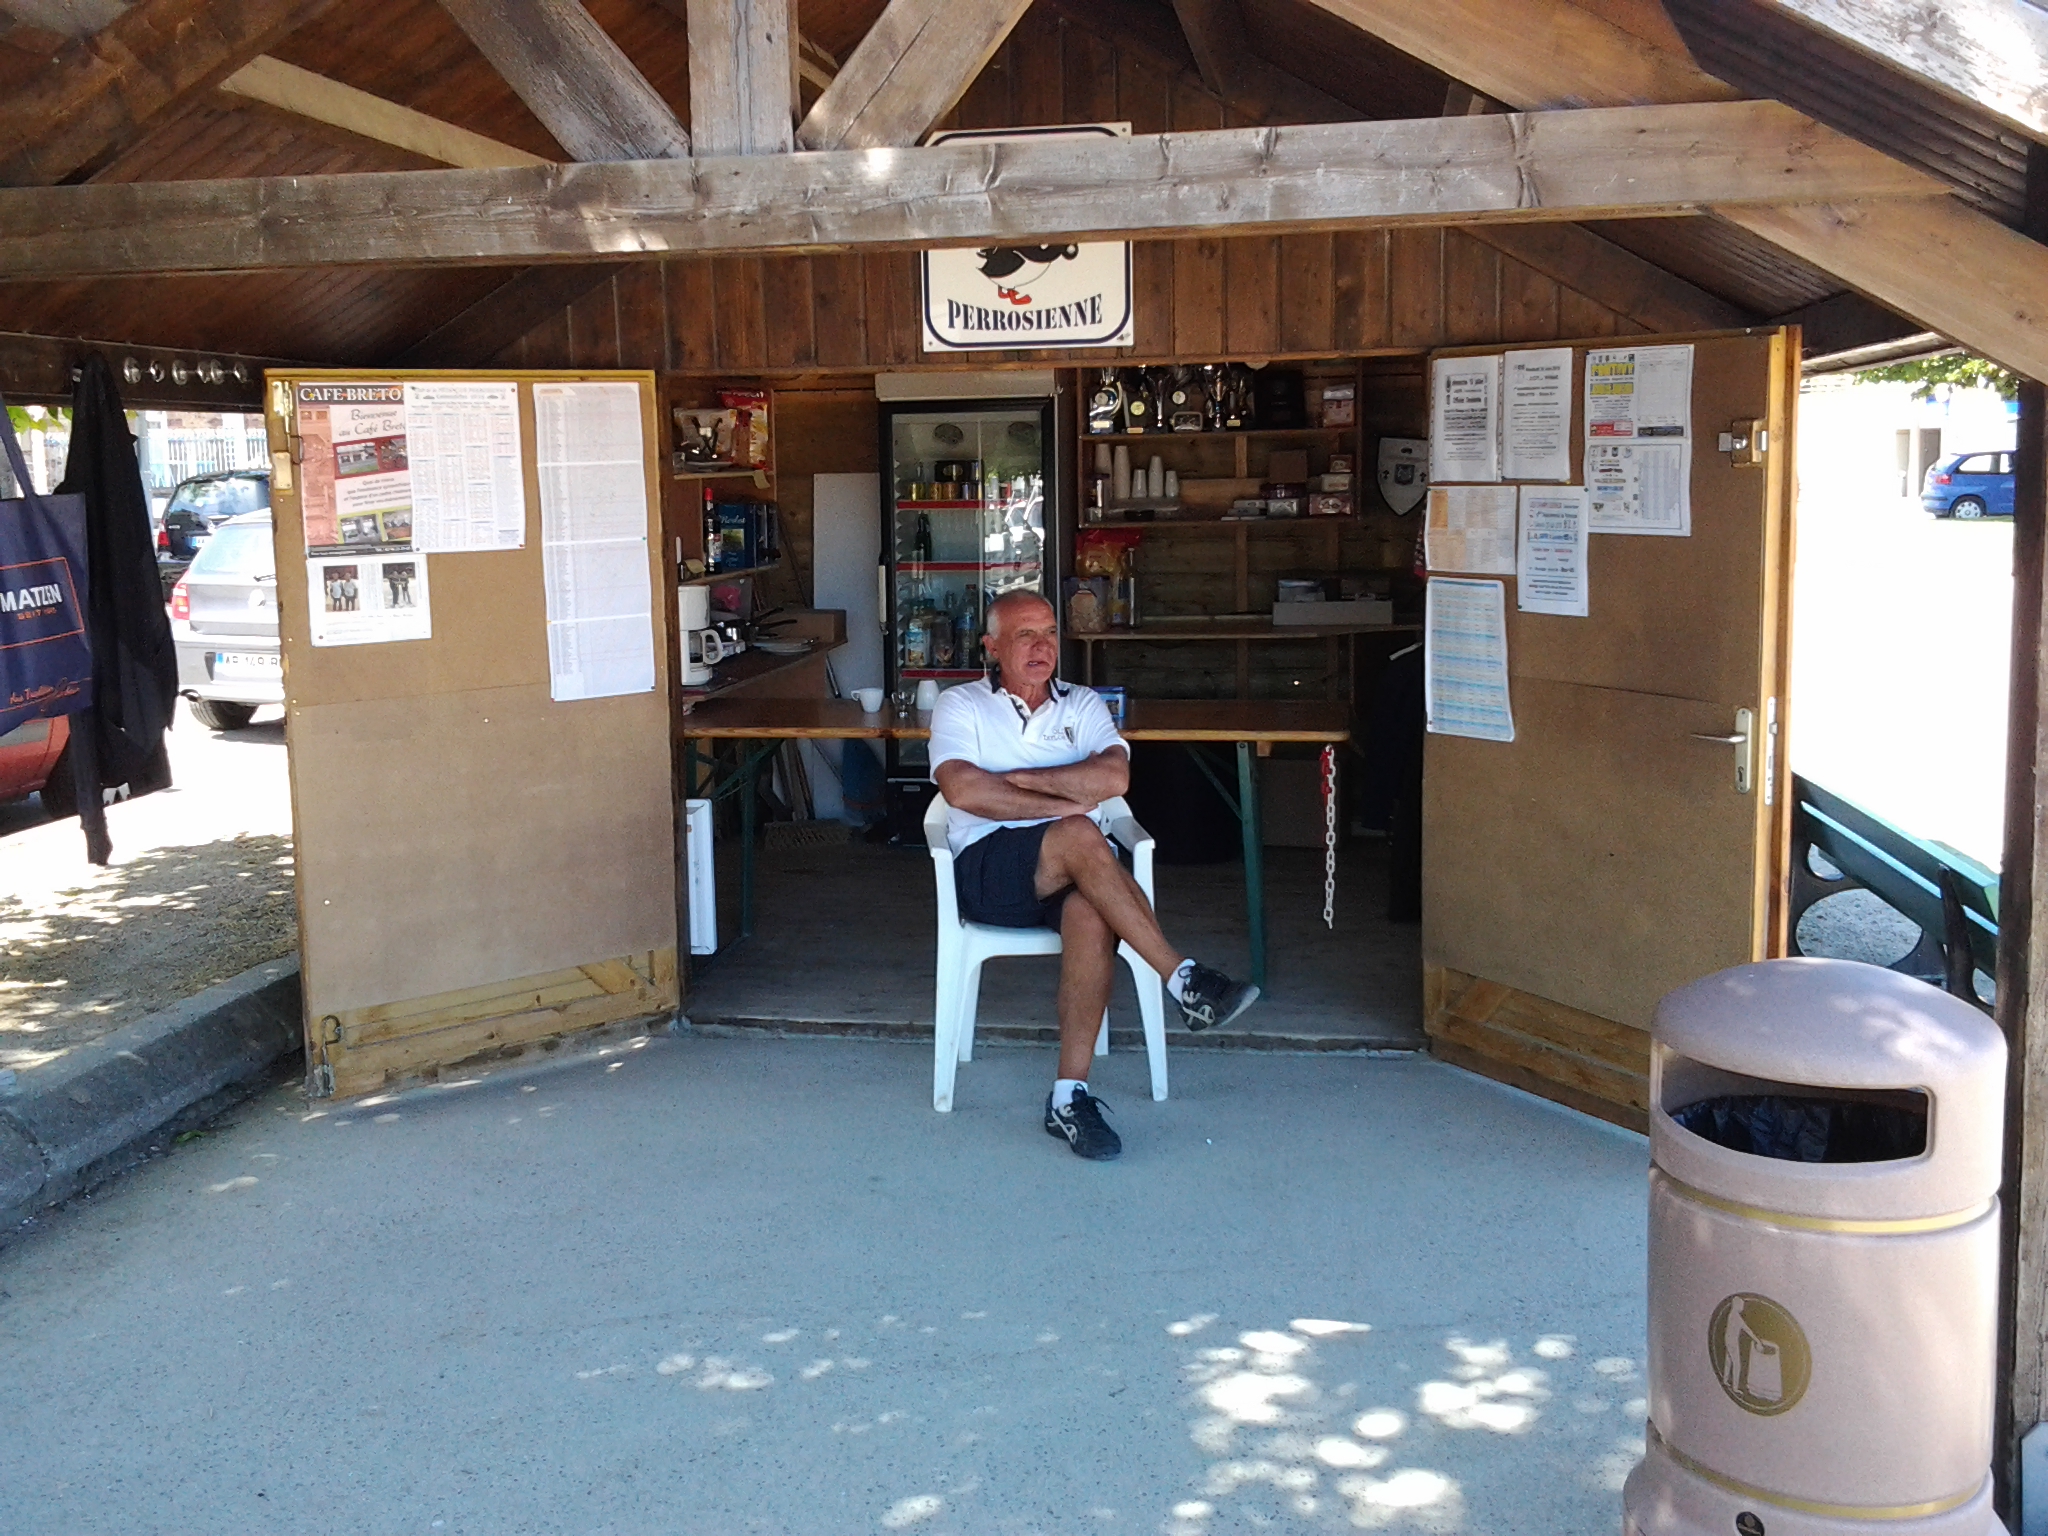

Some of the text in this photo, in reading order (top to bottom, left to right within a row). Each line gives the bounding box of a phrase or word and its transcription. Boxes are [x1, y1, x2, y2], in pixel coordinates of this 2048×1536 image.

[947, 294, 1103, 331] PERROSIENNE
[346, 387, 405, 401] BRETO
[354, 422, 378, 436] Café
[0, 583, 63, 613] MATZEN
